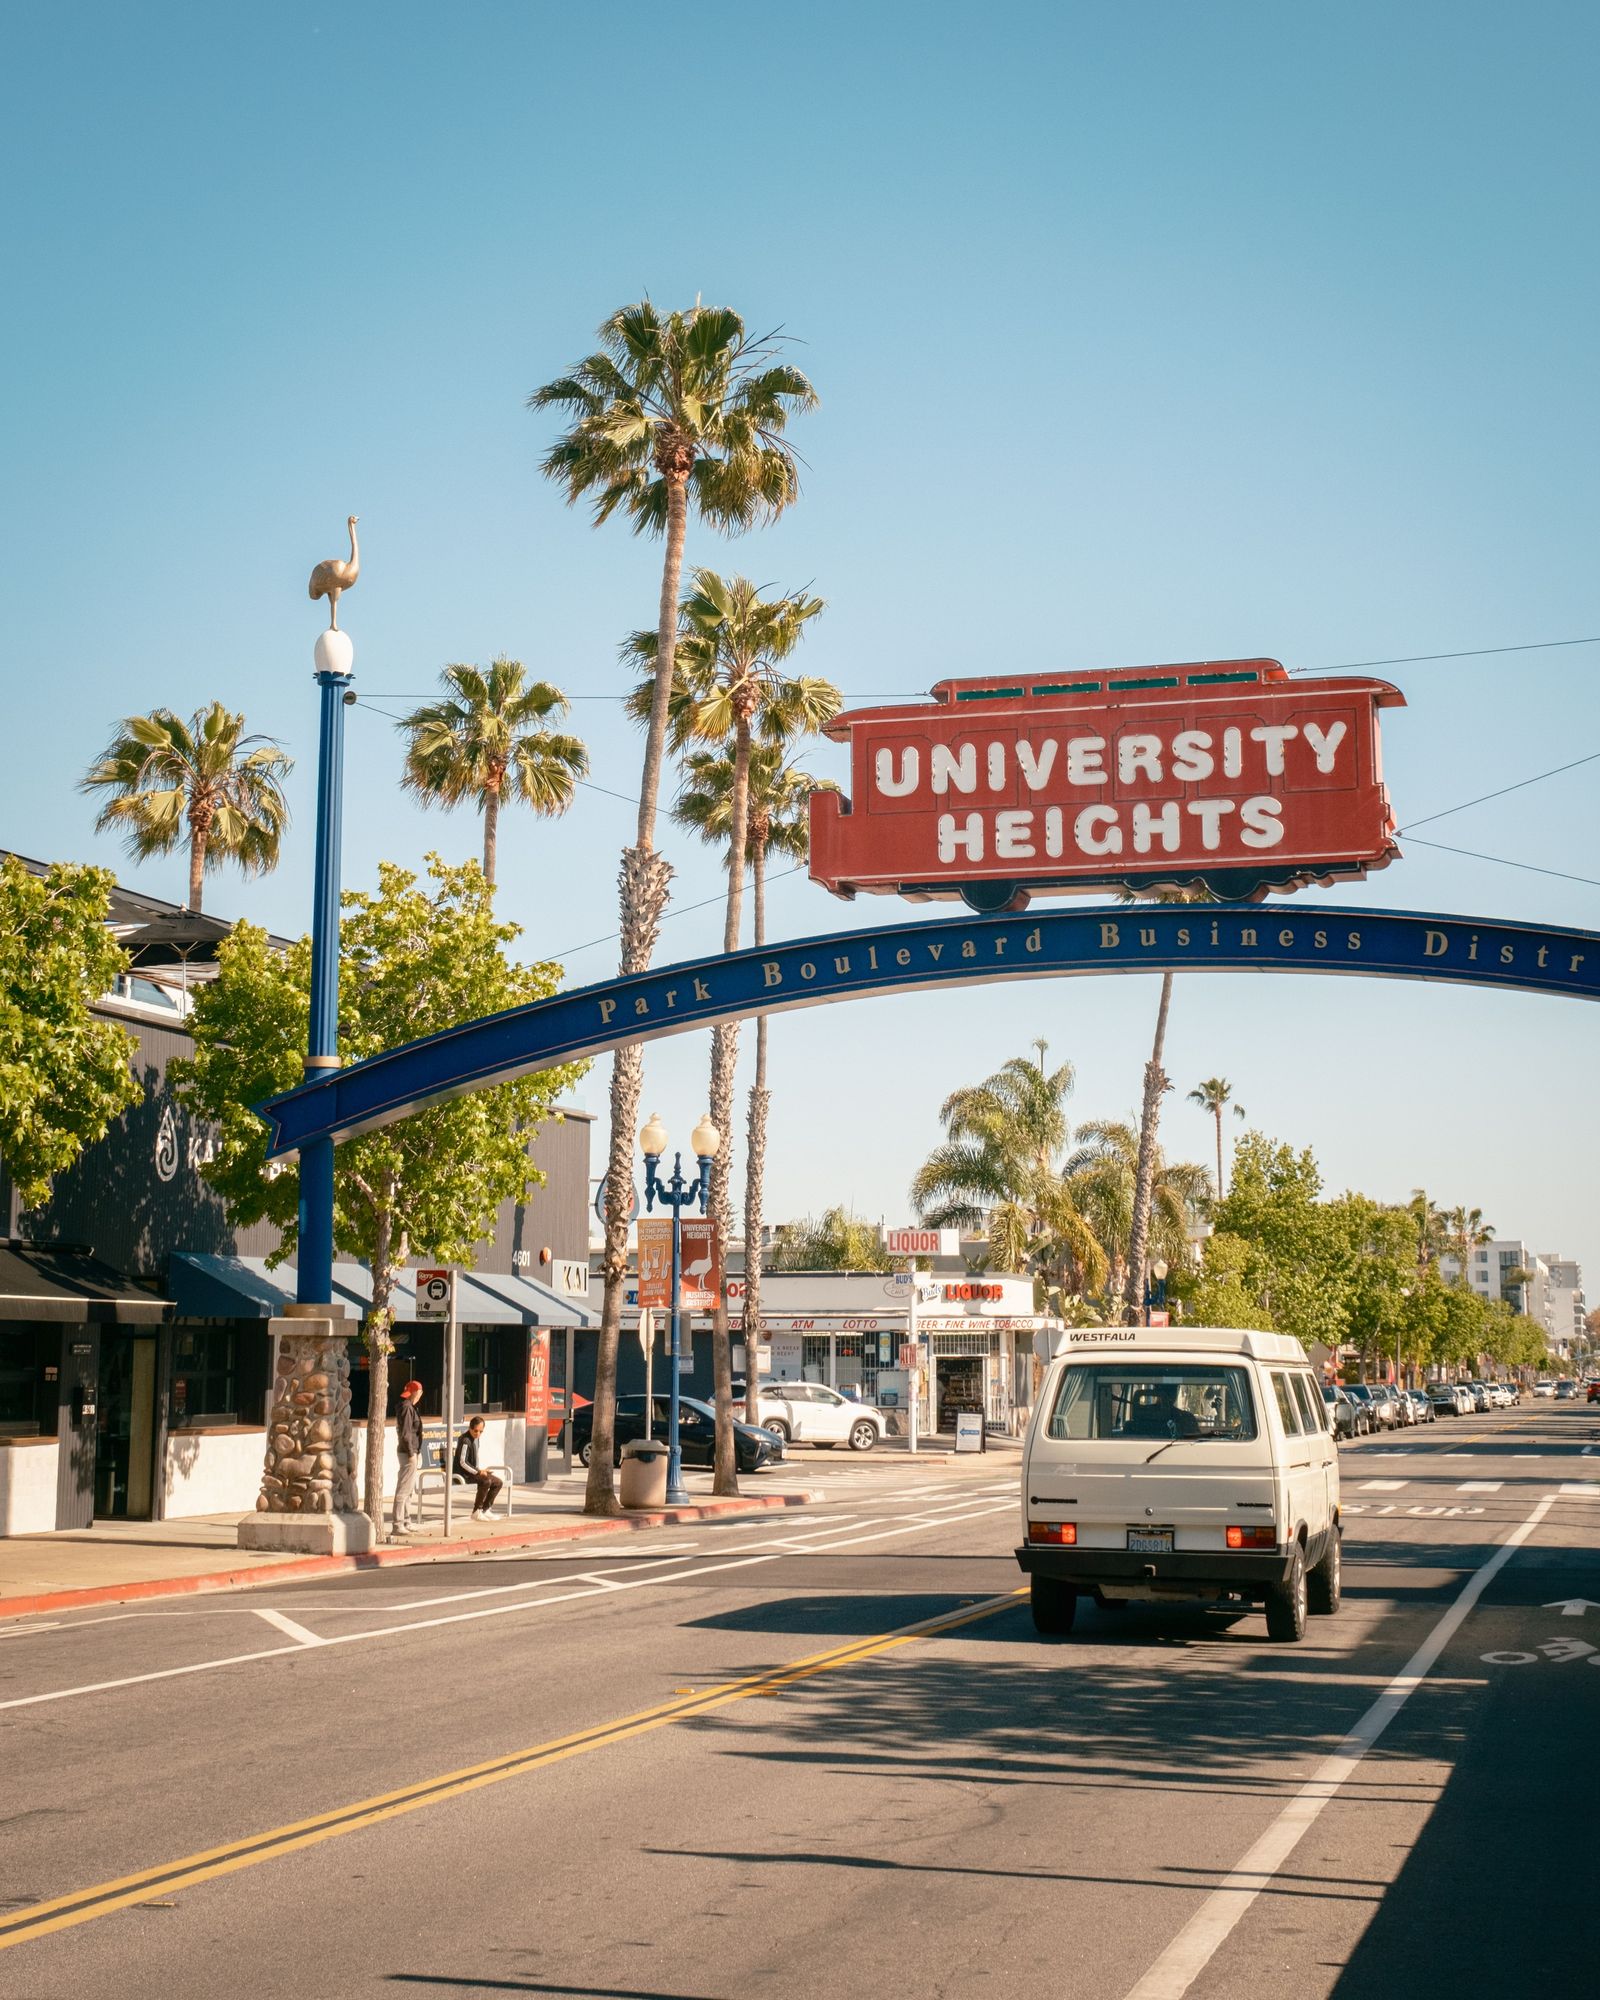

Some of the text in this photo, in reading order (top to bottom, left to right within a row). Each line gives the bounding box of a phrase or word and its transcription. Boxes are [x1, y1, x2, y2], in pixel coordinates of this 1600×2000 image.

[875, 720, 1348, 798] UNIVERSITY
[937, 795, 1285, 864] HEIGHTS
[598, 920, 1586, 1025] Park Boulevard Business Distr
[682, 1223, 715, 1232] UNIVERSITY
[686, 1231, 711, 1240] HEIGHTS
[889, 1232, 939, 1252] LIQUOR
[512, 1250, 531, 1267] 4601
[895, 1274, 913, 1285] BUD'S
[685, 1291, 715, 1299] BUSINESS
[945, 1283, 1004, 1301] LIQUOR
[685, 1298, 714, 1307] DISTRICT
[791, 1319, 815, 1329] ATM
[842, 1319, 878, 1329] LOTTO
[916, 1319, 1034, 1329] BEER FINE WINE TOBACCO
[1069, 1332, 1136, 1342] WESTFALIA
[1340, 1503, 1486, 1517] STOP
